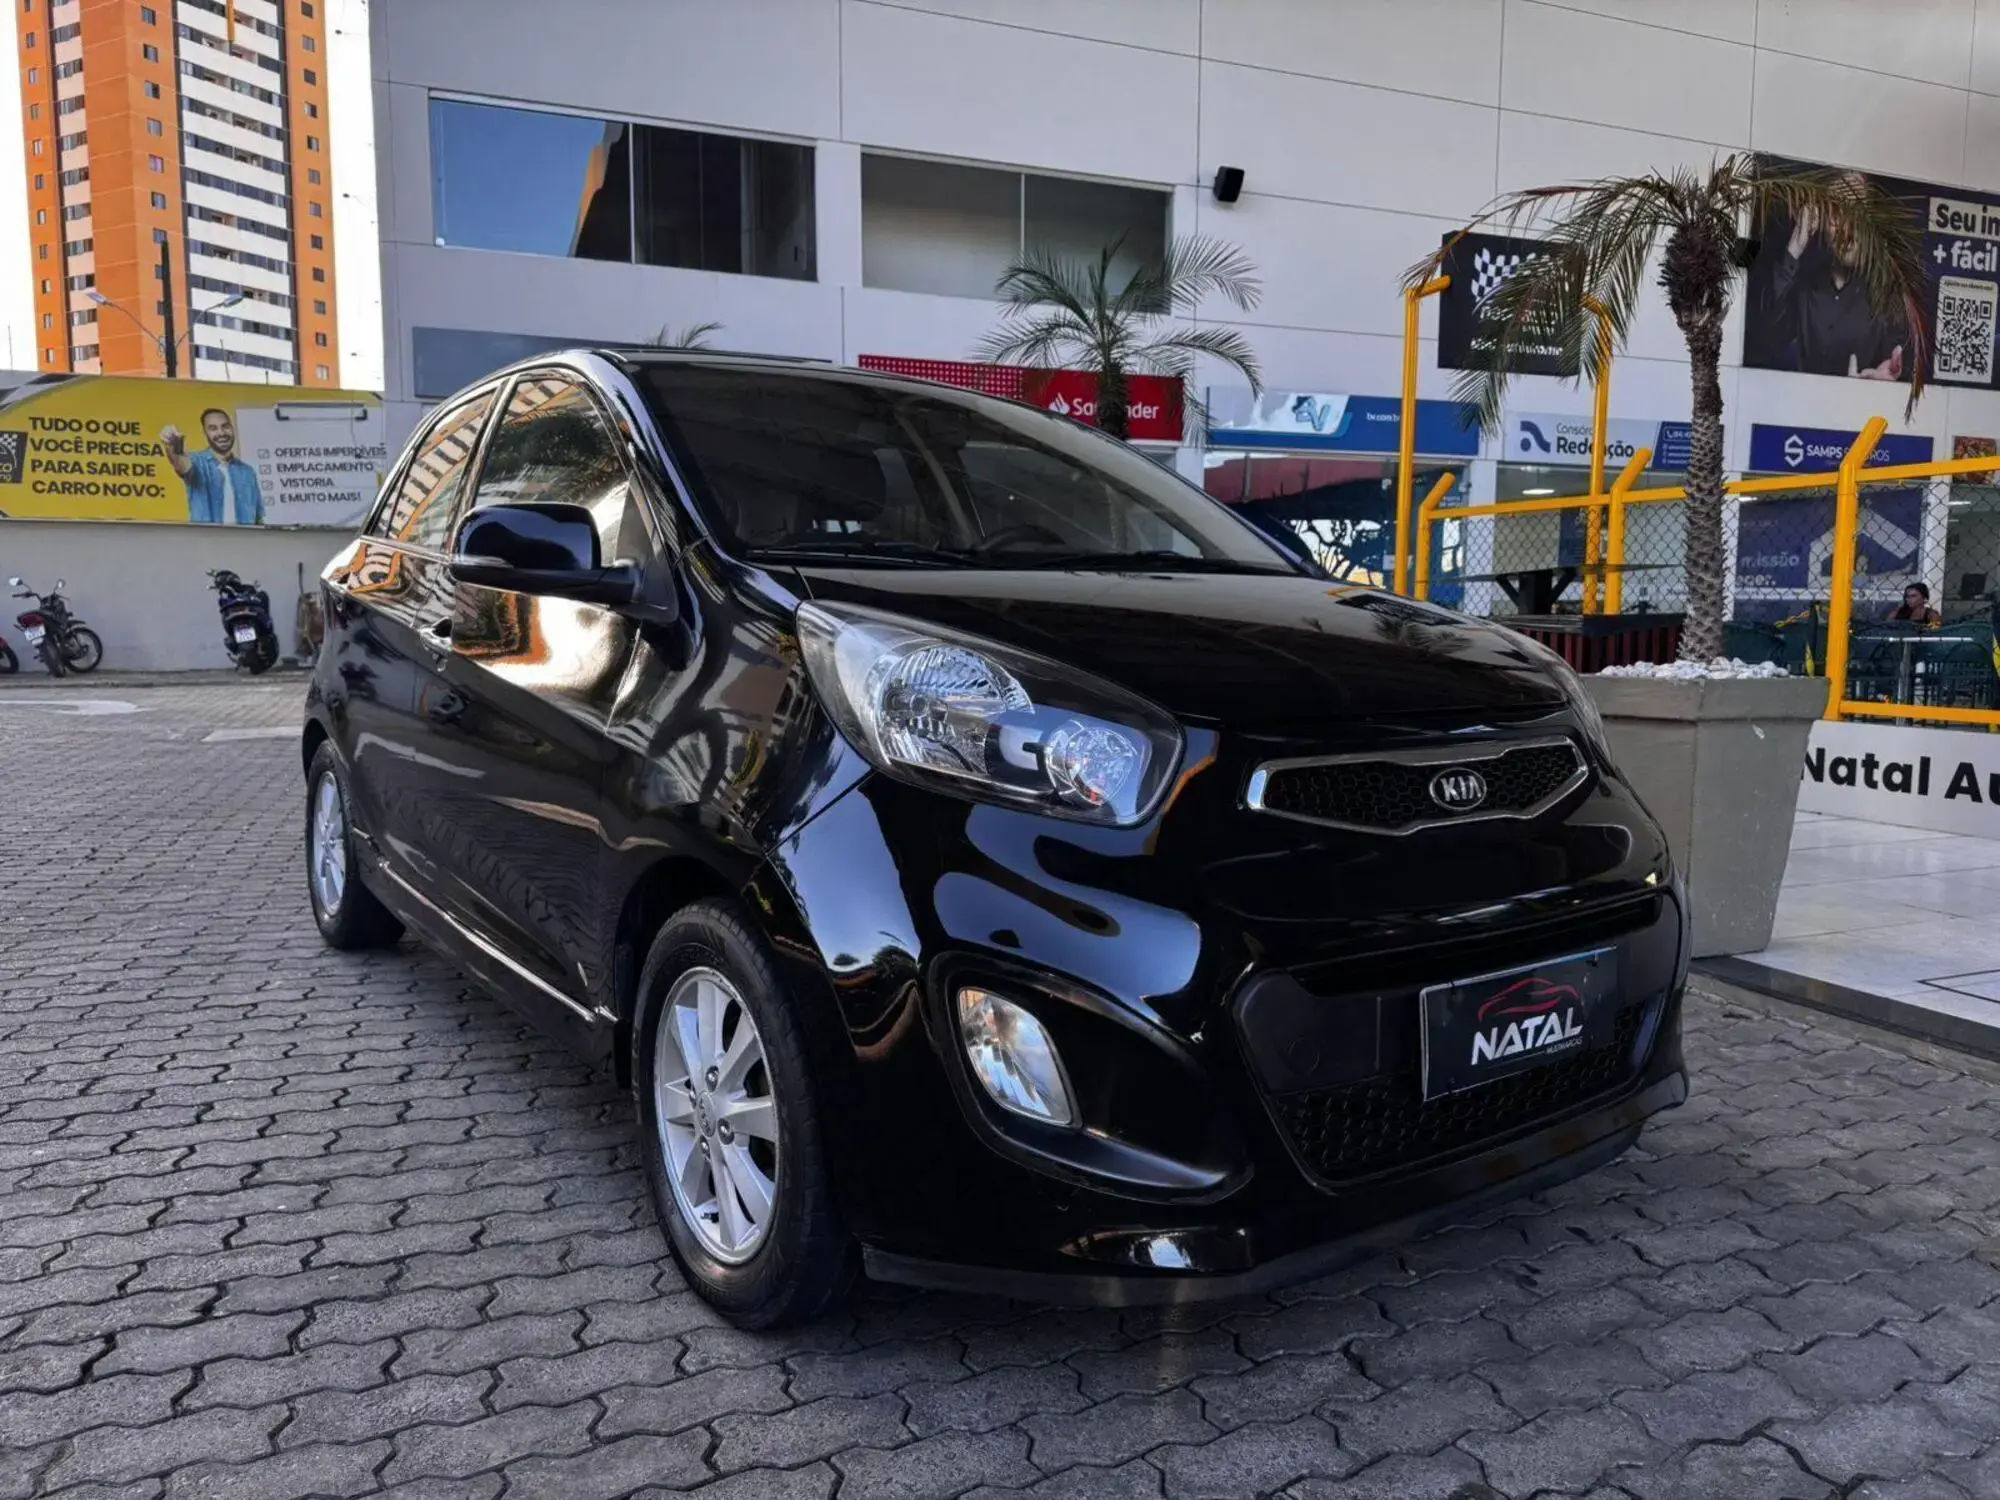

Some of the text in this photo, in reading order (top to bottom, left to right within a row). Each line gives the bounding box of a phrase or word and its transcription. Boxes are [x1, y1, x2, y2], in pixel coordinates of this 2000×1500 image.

[1936, 203, 1976, 233] Seu
[1950, 240, 1997, 272] fácil
[1072, 398, 1159, 419] Sander
[1366, 411, 1401, 422] bv.com.b
[28, 416, 141, 436] TUDO O QUE
[1556, 422, 1594, 436] Consórc
[29, 436, 164, 457] VOCÊ PRECISA
[275, 445, 386, 458] OFERTAS IMPERDÍVEIS
[1556, 436, 1635, 460] Redção
[1806, 444, 1842, 459] SAMPS
[31, 459, 156, 477] PARA SAIR DE
[276, 462, 374, 473] EMPLACAMENTO
[32, 480, 165, 498] CARRO NOVO:
[280, 478, 335, 488] VISTORIA
[280, 492, 361, 503] E MUITO MAIS!
[1800, 747, 1931, 796] Natal
[1440, 775, 1481, 801] KIA
[1471, 1007, 1583, 1065] NATAL
